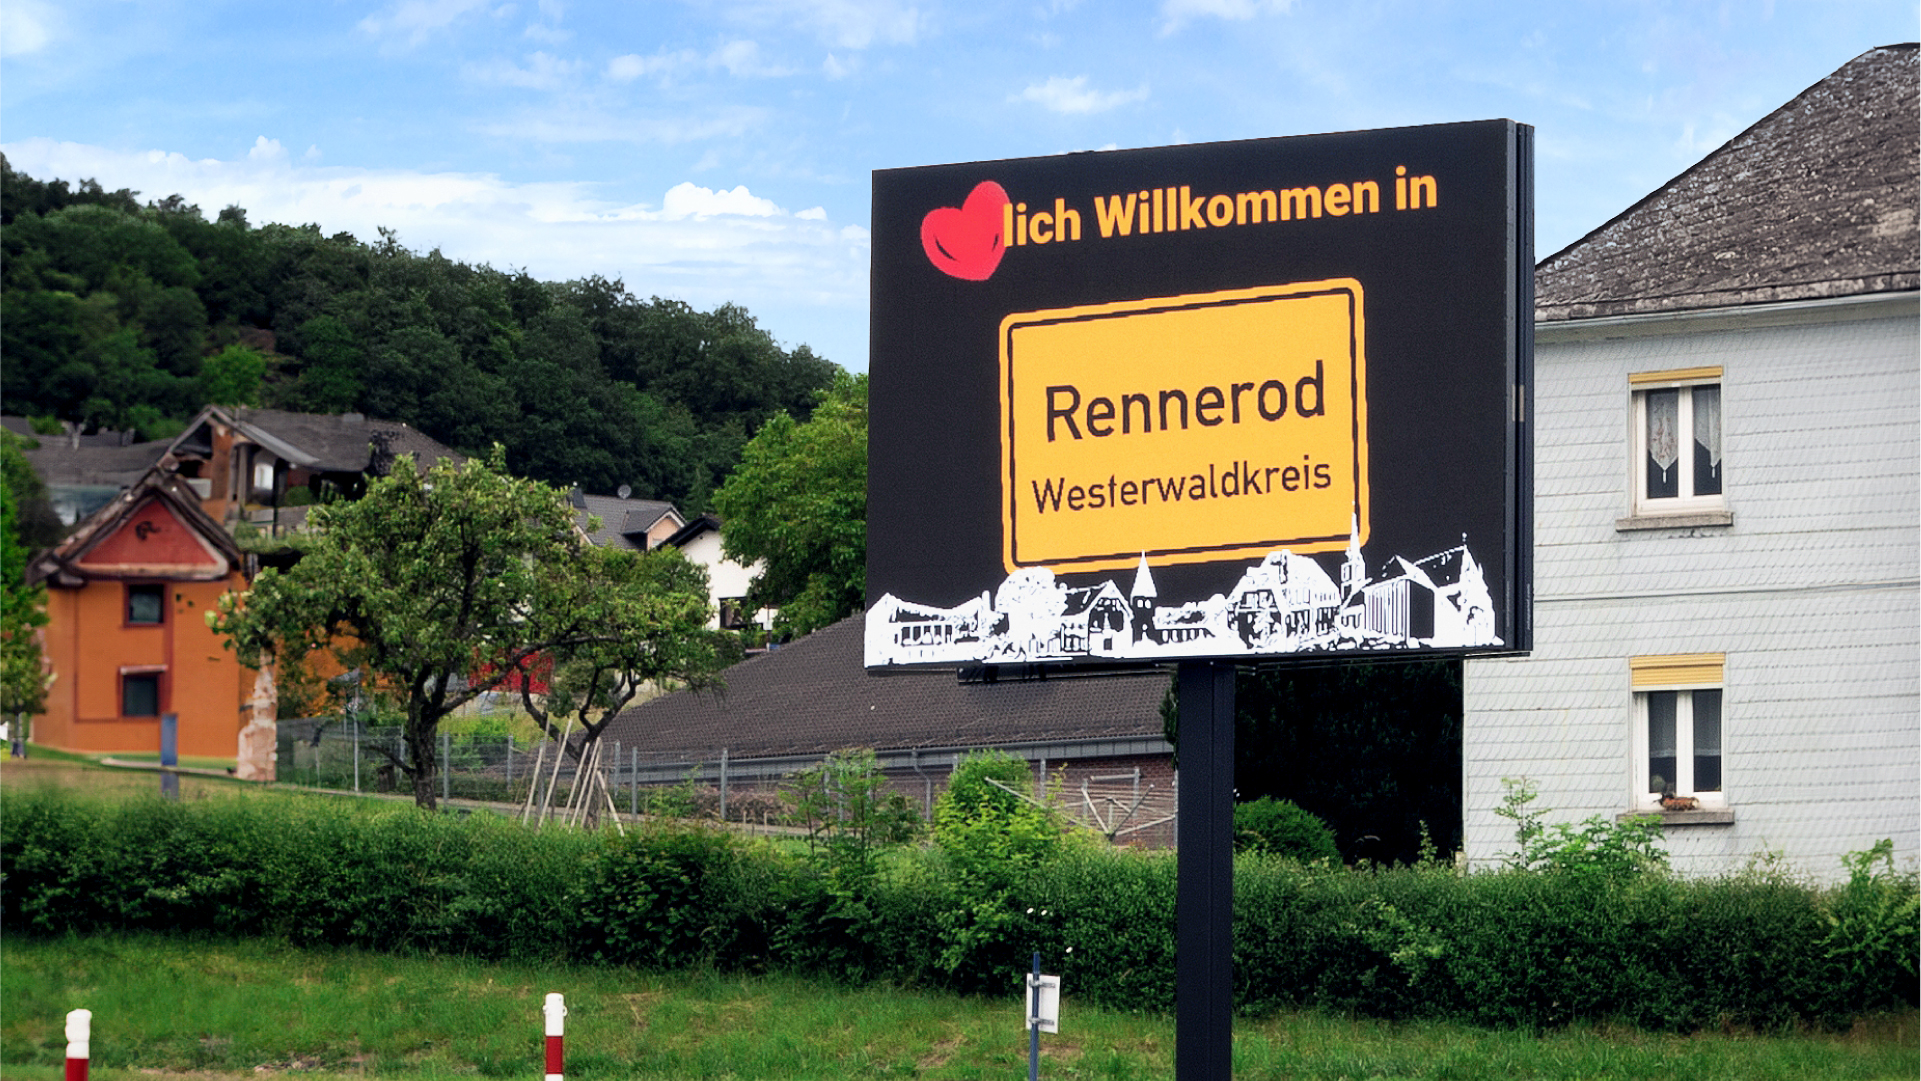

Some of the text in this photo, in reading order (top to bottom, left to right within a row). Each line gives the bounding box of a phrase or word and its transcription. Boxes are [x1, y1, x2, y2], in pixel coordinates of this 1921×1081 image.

[1003, 166, 1437, 247] lich Willkommen in
[1046, 359, 1326, 443] Rennerod
[1031, 455, 1332, 514] Westerwaldkreis
